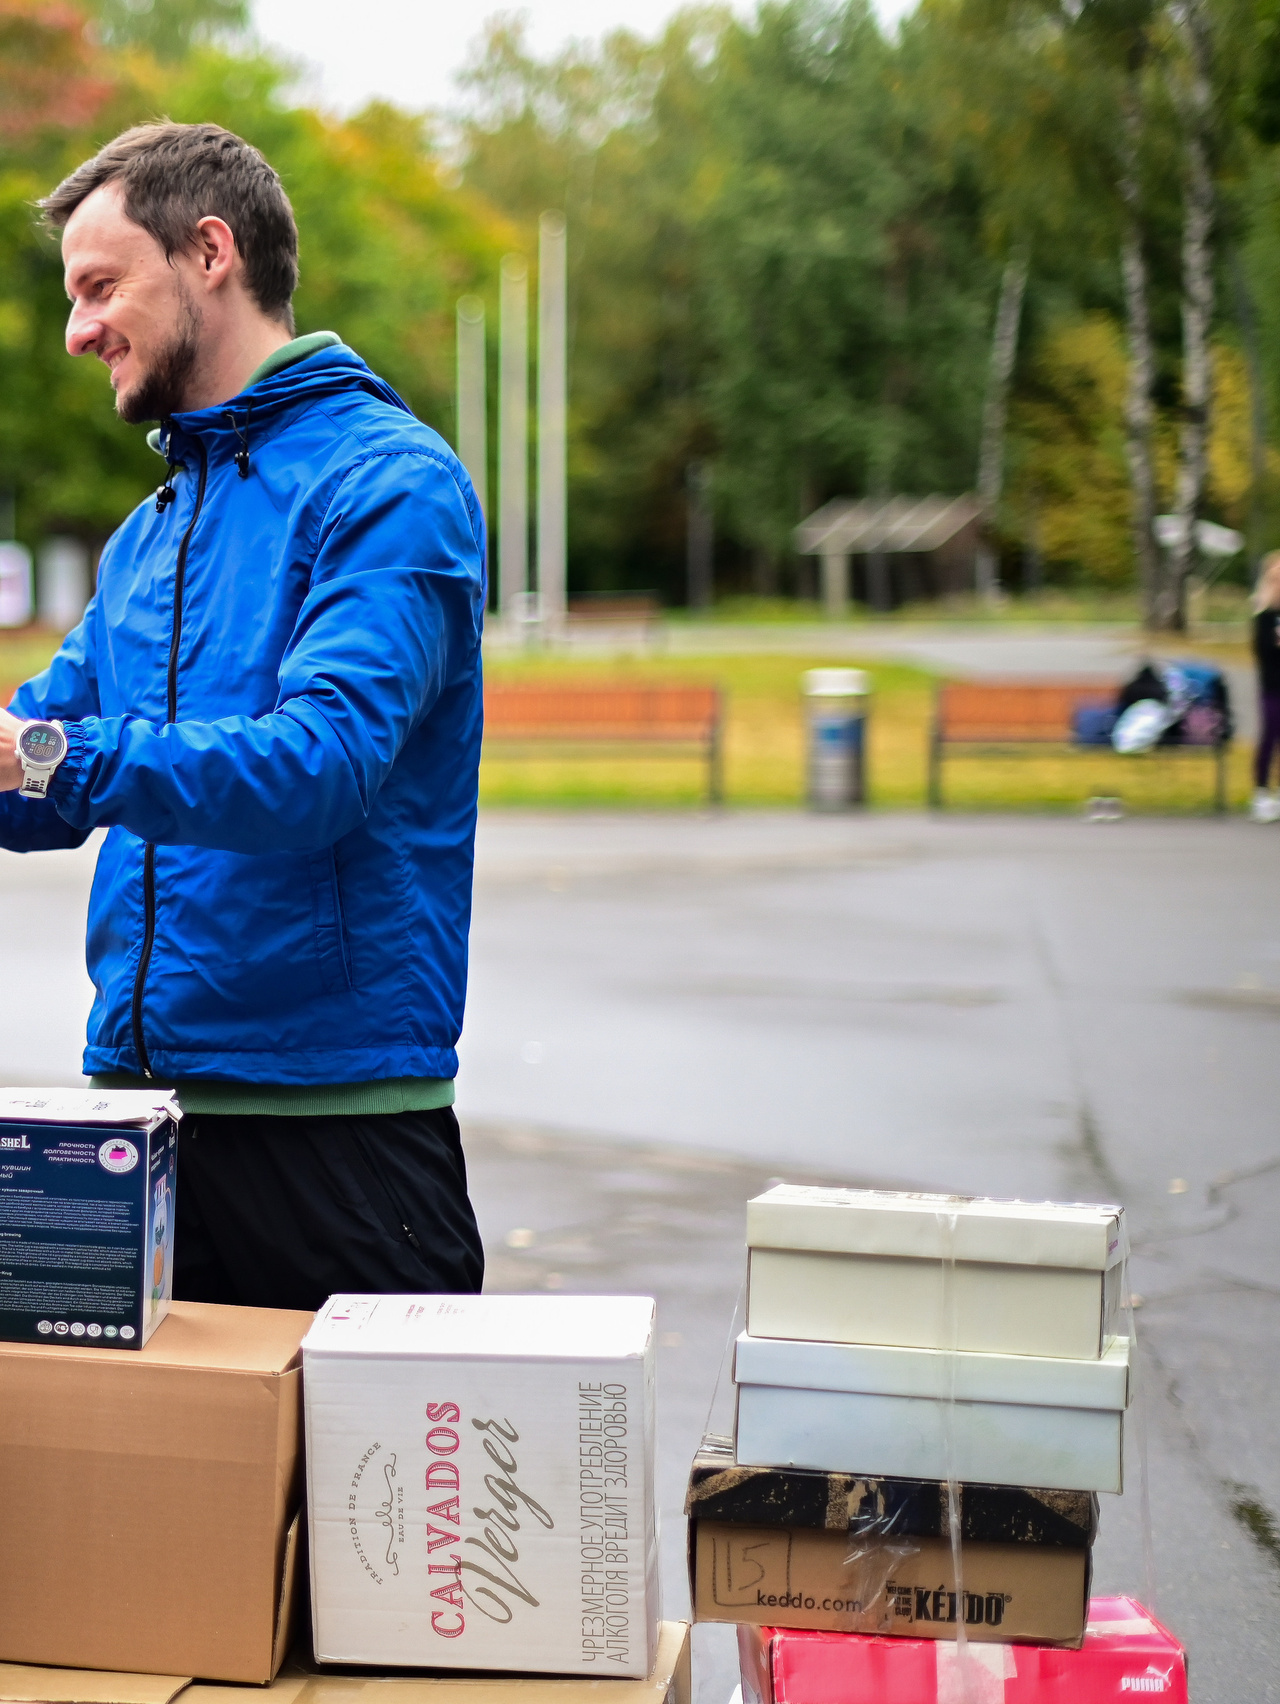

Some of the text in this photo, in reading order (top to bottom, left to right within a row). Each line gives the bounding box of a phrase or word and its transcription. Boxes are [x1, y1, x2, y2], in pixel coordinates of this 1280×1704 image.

[48, 1156, 95, 1164] ПРАКТИЧНОСТЬ
[349, 1442, 383, 1585] TRADITION DE FRANCE
[398, 1508, 404, 1520] DE
[426, 1401, 465, 1638] CALVADOS
[454, 1417, 554, 1624] Verger
[579, 1382, 605, 1662] ЧРЕЗМЕРНОЕ УПОТРЕБЛЕНИЕ
[603, 1383, 629, 1664] АЛКОГОЛЯ ВРЕДИТ ЗДОРОВЬЮ
[756, 1590, 864, 1614] keddo.com
[1121, 1677, 1164, 1692] PUMA
